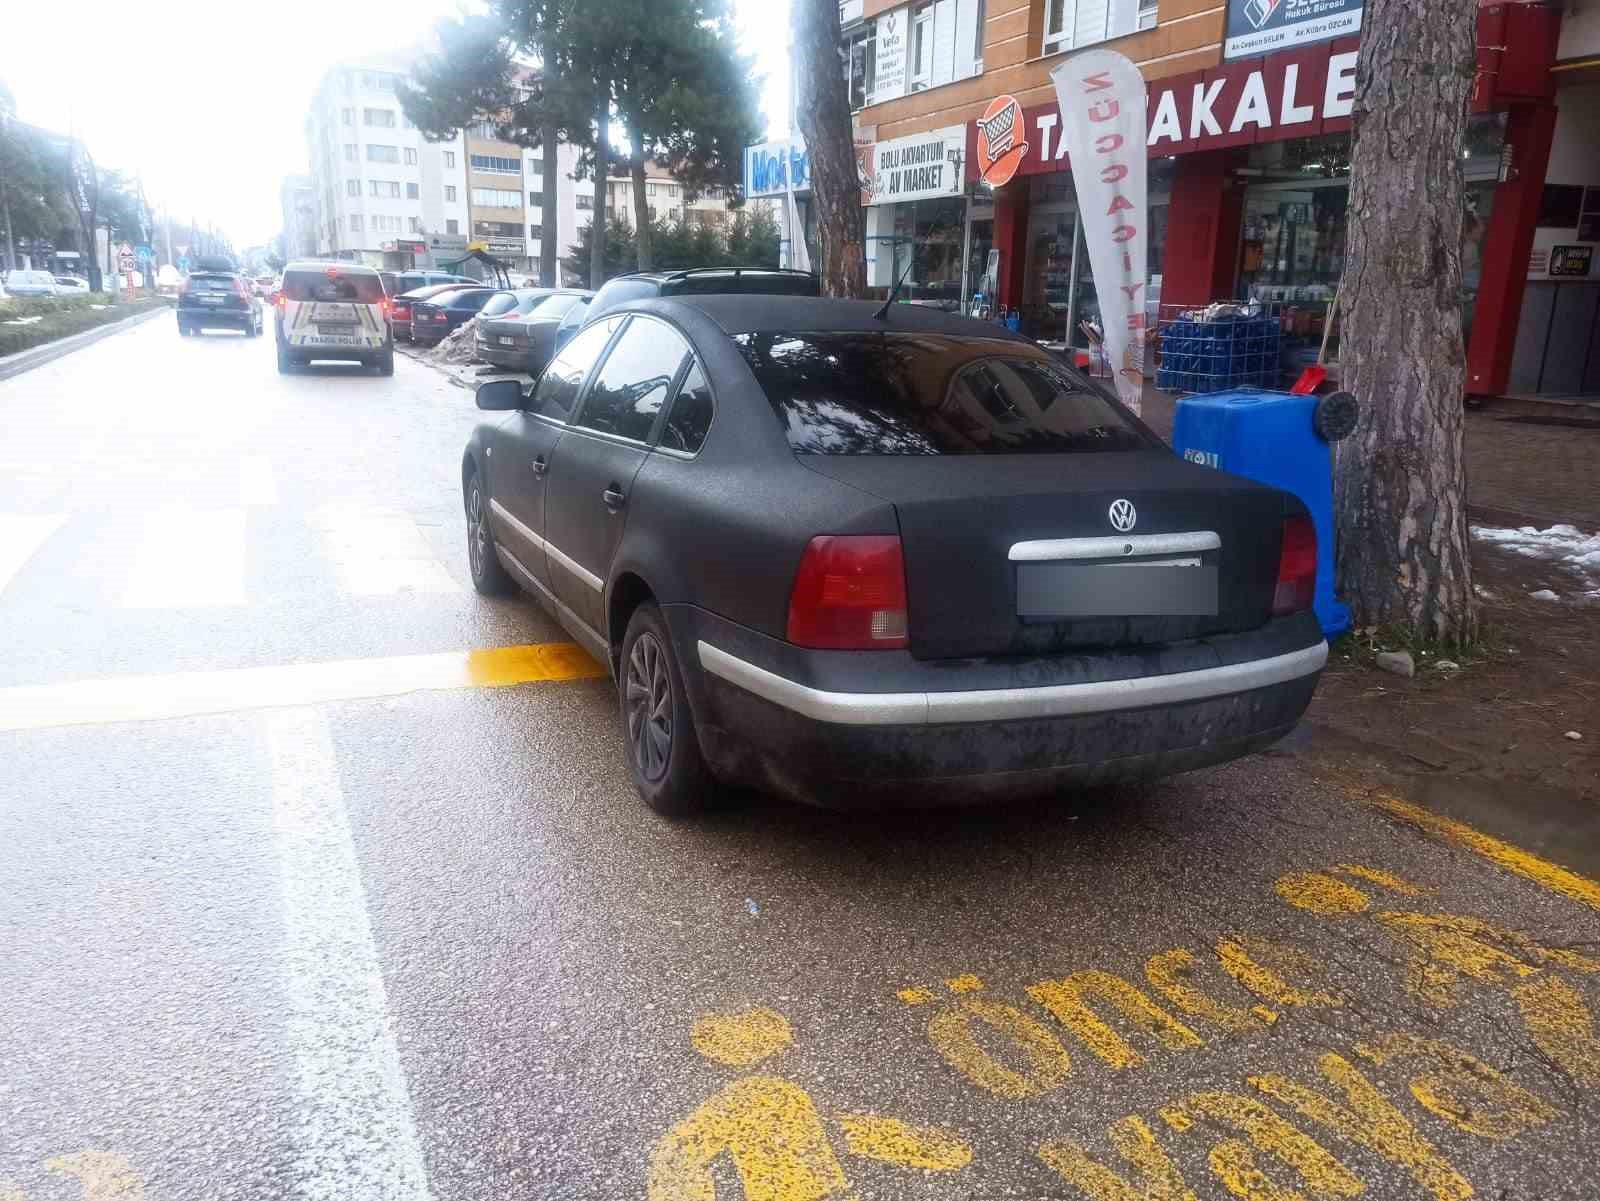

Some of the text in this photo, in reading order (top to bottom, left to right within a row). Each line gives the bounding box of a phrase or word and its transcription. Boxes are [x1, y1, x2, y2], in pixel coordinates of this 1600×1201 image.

[881, 141, 944, 170] BOLU AKVARYUM
[889, 164, 944, 194] AV MARKET
